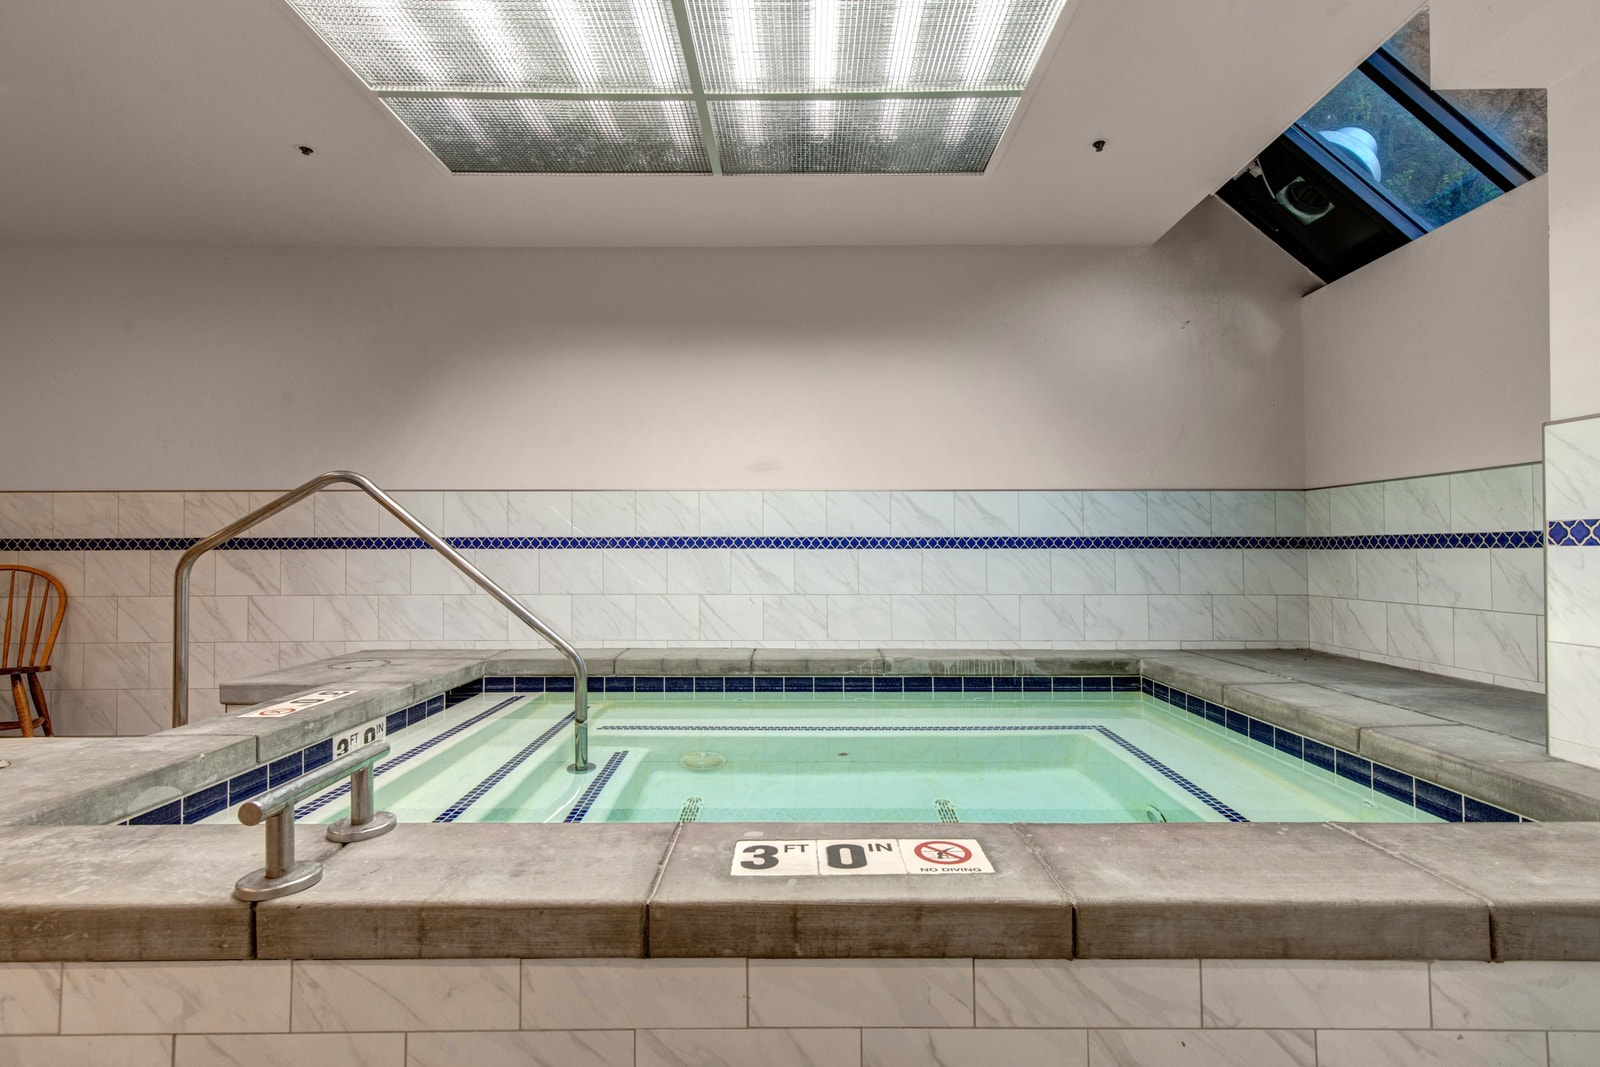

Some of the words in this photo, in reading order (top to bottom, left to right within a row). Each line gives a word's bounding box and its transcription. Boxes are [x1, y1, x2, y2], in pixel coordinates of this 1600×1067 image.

[336, 738, 349, 757] 3
[350, 732, 359, 746] FT
[376, 722, 384, 735] IN
[740, 844, 779, 870] 3
[784, 843, 809, 853] FT
[826, 843, 868, 869] 0
[868, 842, 893, 852] IN
